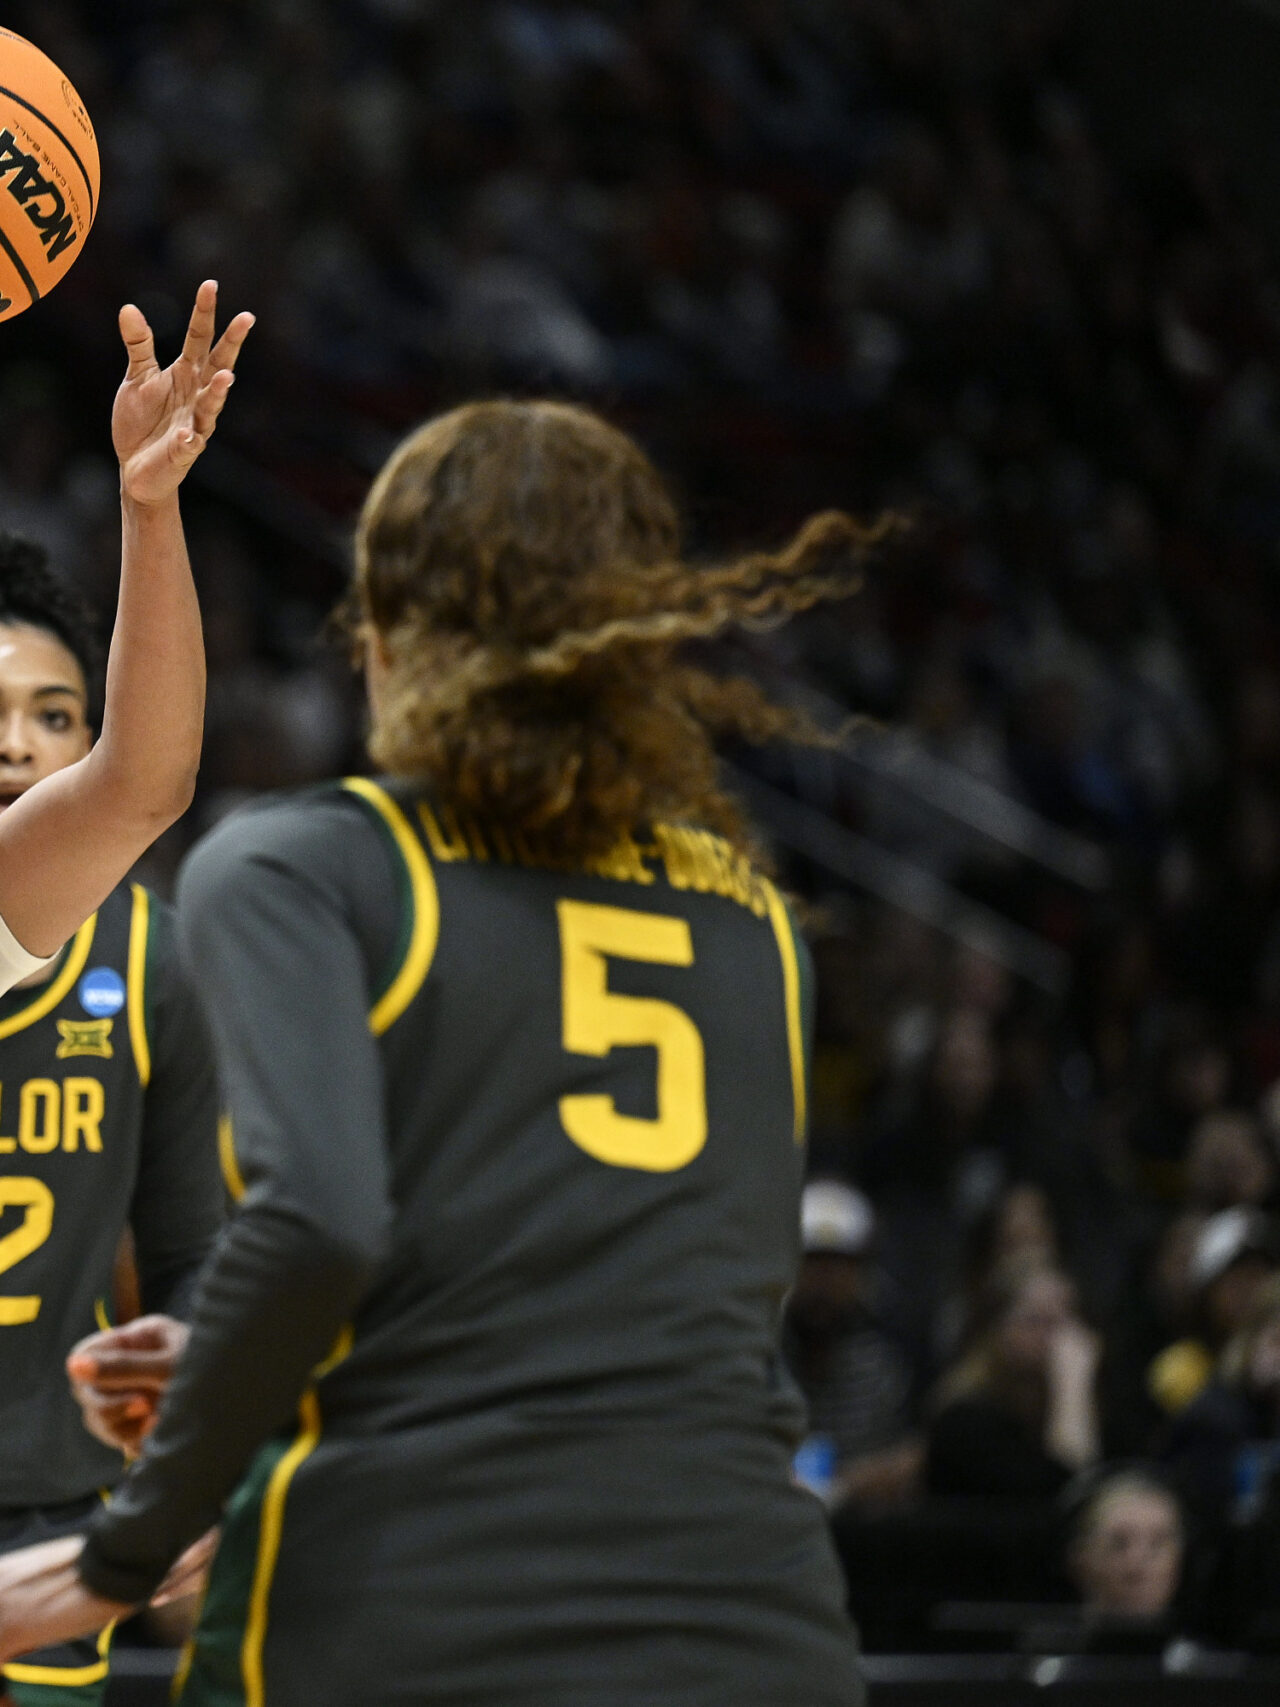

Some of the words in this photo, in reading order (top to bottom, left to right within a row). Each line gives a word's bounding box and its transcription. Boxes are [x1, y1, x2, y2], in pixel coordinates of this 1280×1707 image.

[13, 119, 41, 153] BALL
[41, 151, 67, 188] GAME
[556, 897, 709, 1173] 5
